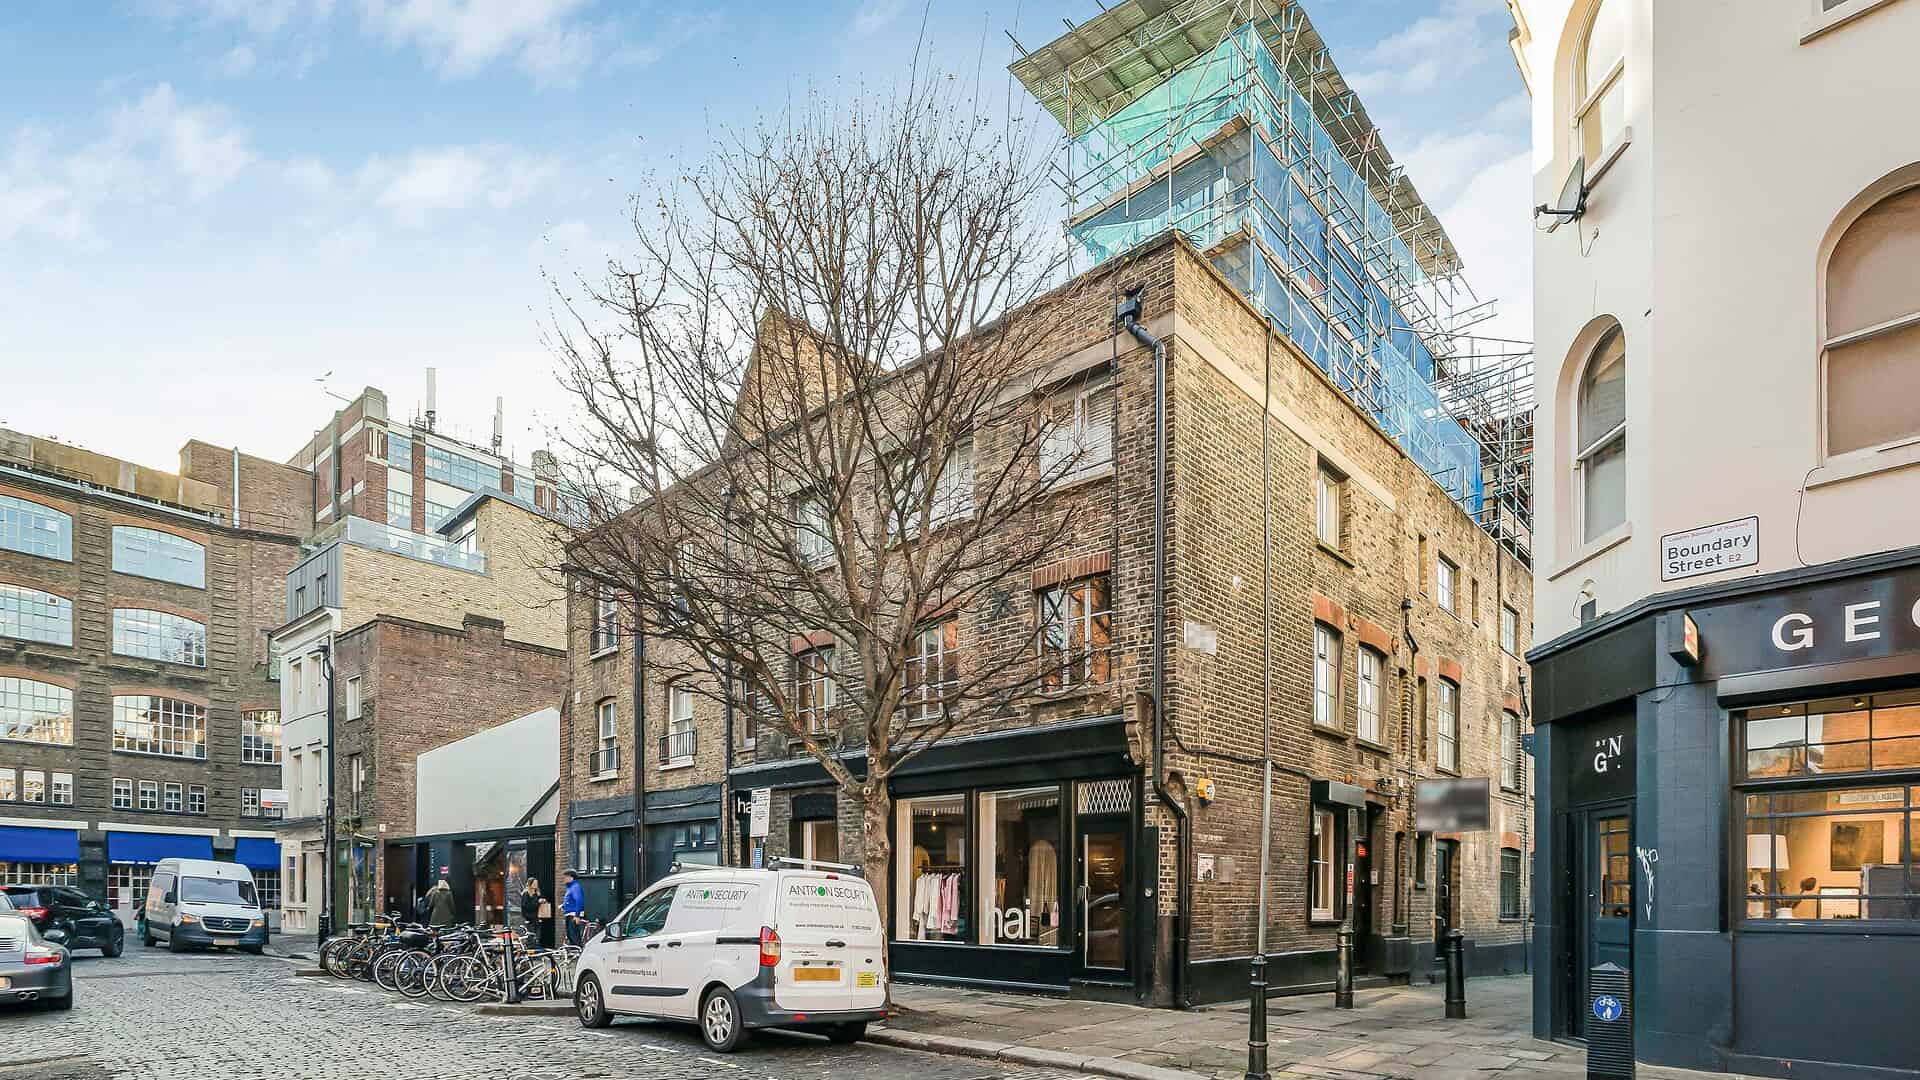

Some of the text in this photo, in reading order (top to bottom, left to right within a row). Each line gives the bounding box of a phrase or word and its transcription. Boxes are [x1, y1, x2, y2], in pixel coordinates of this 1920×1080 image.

[1667, 534, 1752, 560] Boundary
[1669, 553, 1742, 574] Street E2
[1771, 597, 1920, 652] GE
[737, 796, 752, 814] ha
[985, 896, 1031, 940] hai
